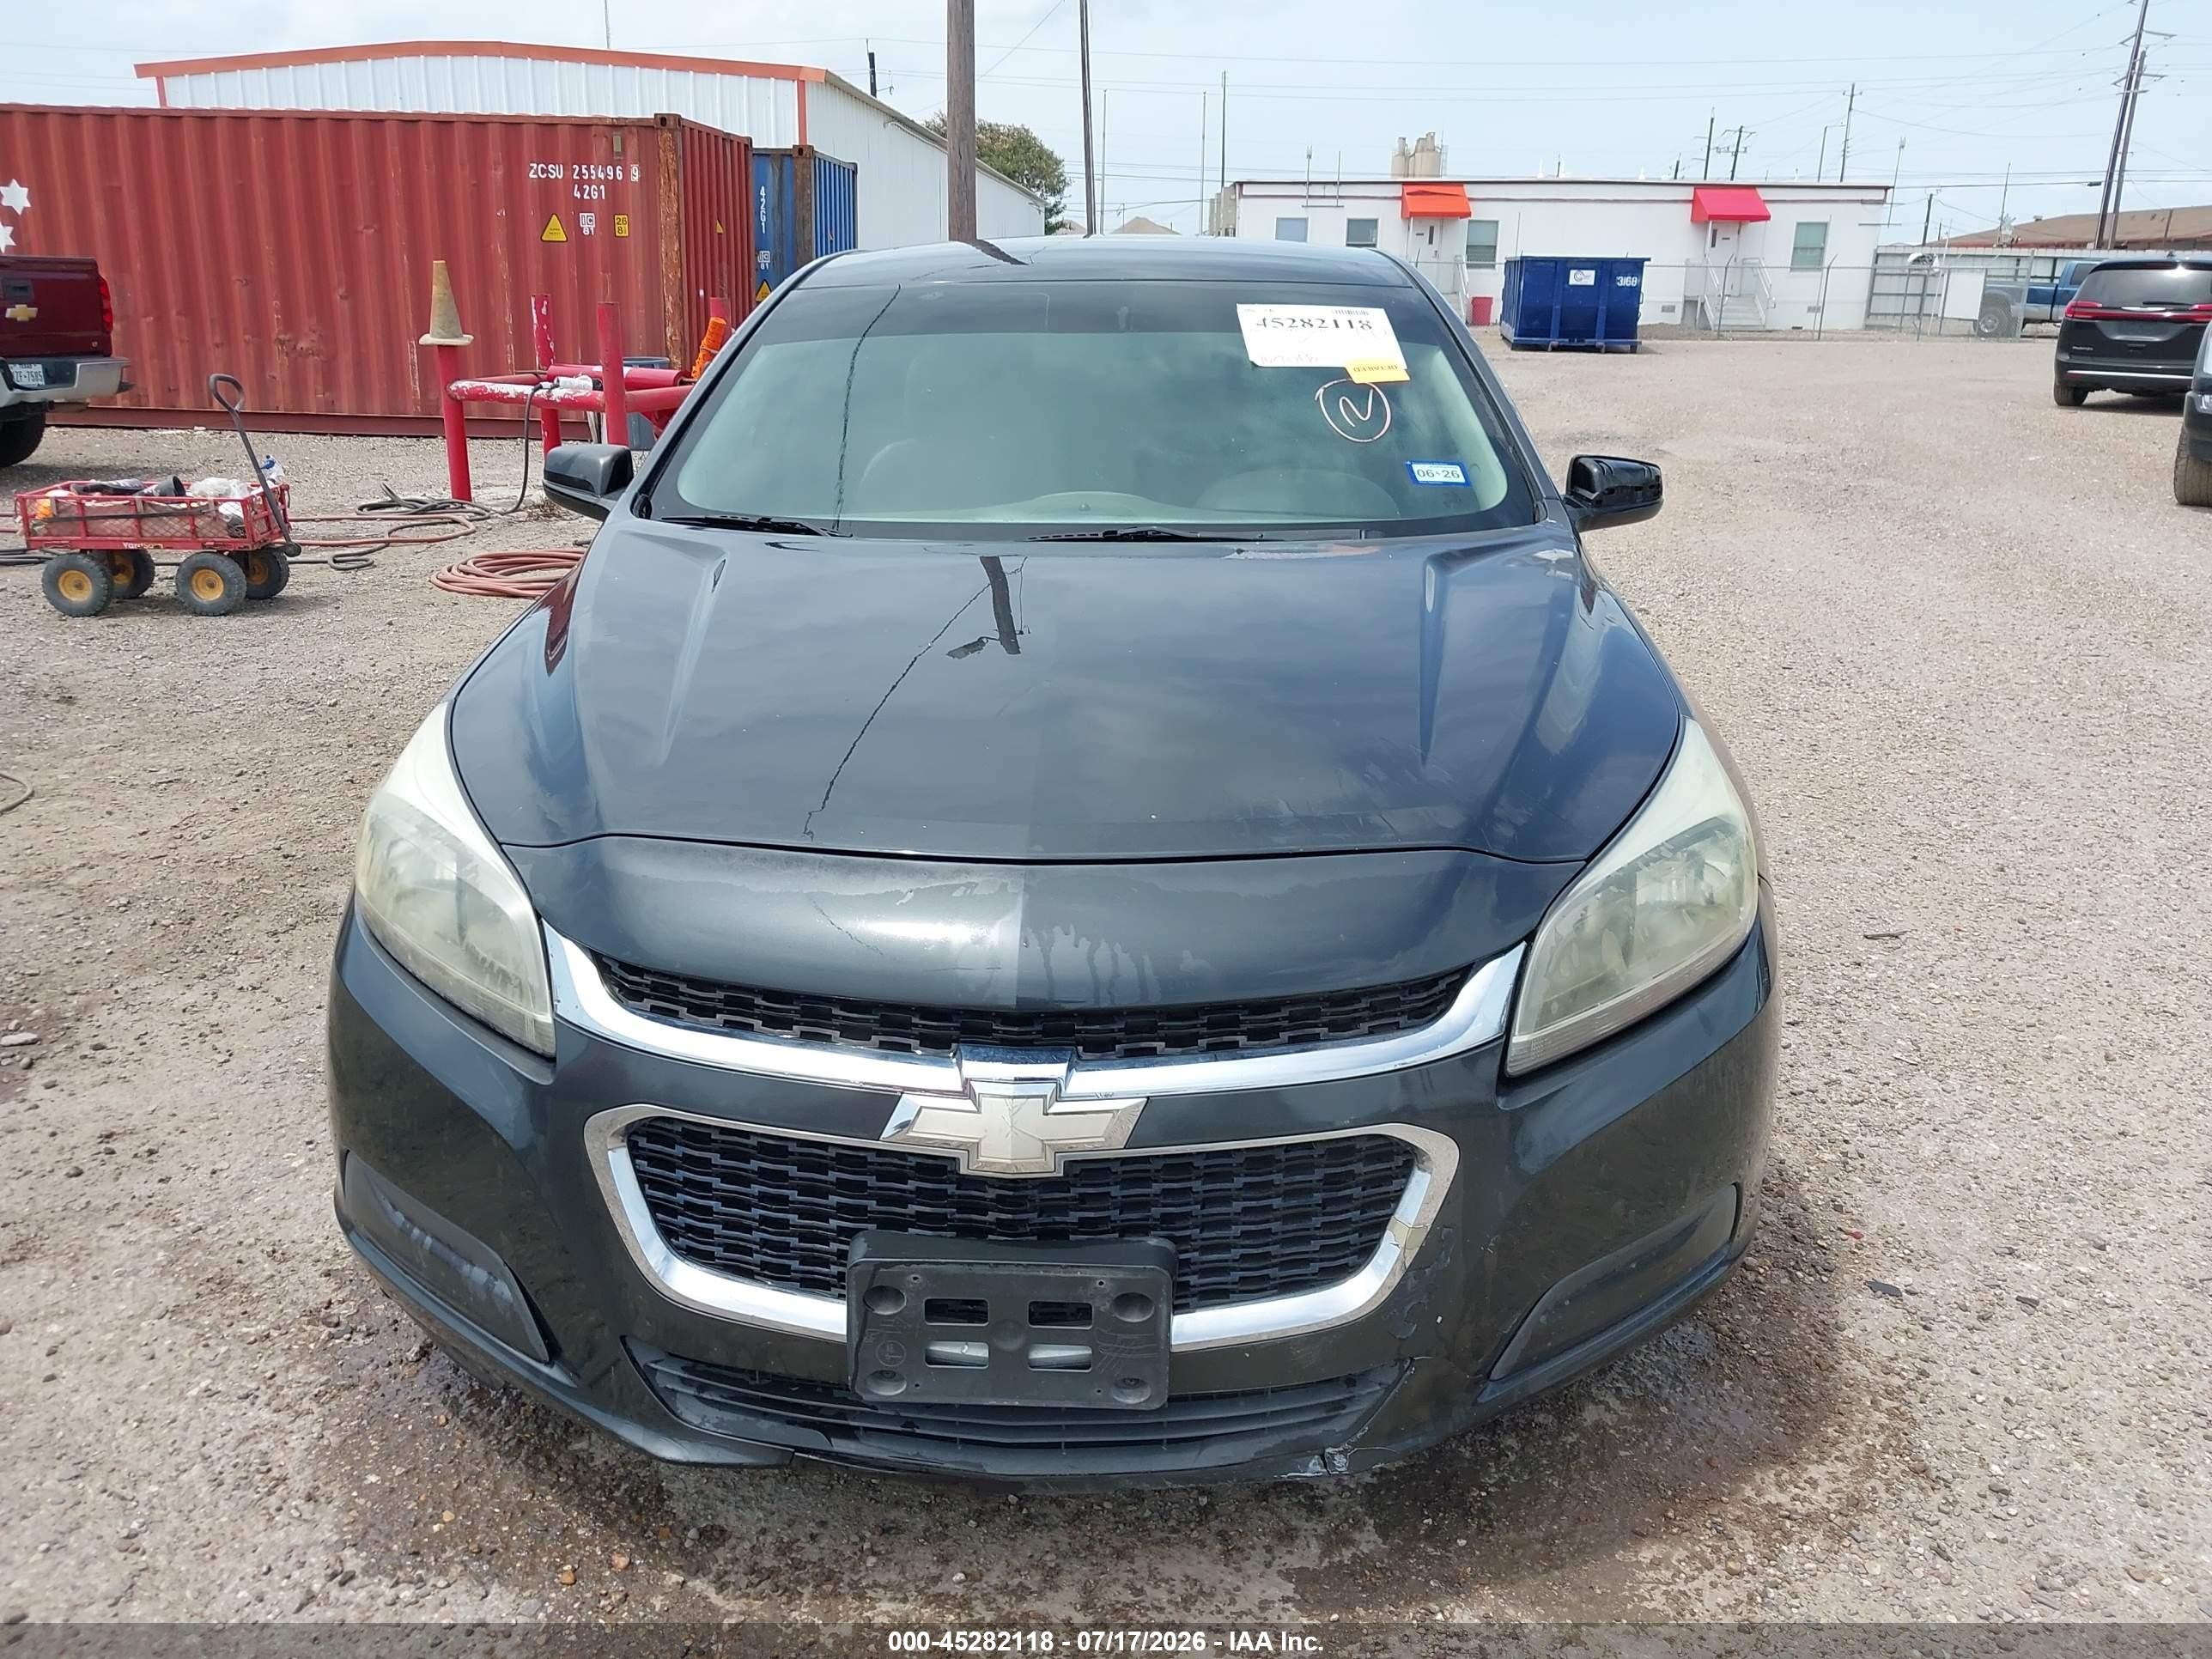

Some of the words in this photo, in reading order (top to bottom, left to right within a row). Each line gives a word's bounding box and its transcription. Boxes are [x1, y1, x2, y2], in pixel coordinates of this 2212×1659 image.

[529, 163, 563, 179] ZCSU
[573, 164, 623, 179] 255496
[631, 164, 639, 182] 9
[574, 184, 605, 199] 42G1
[1256, 317, 1372, 330] 45282118
